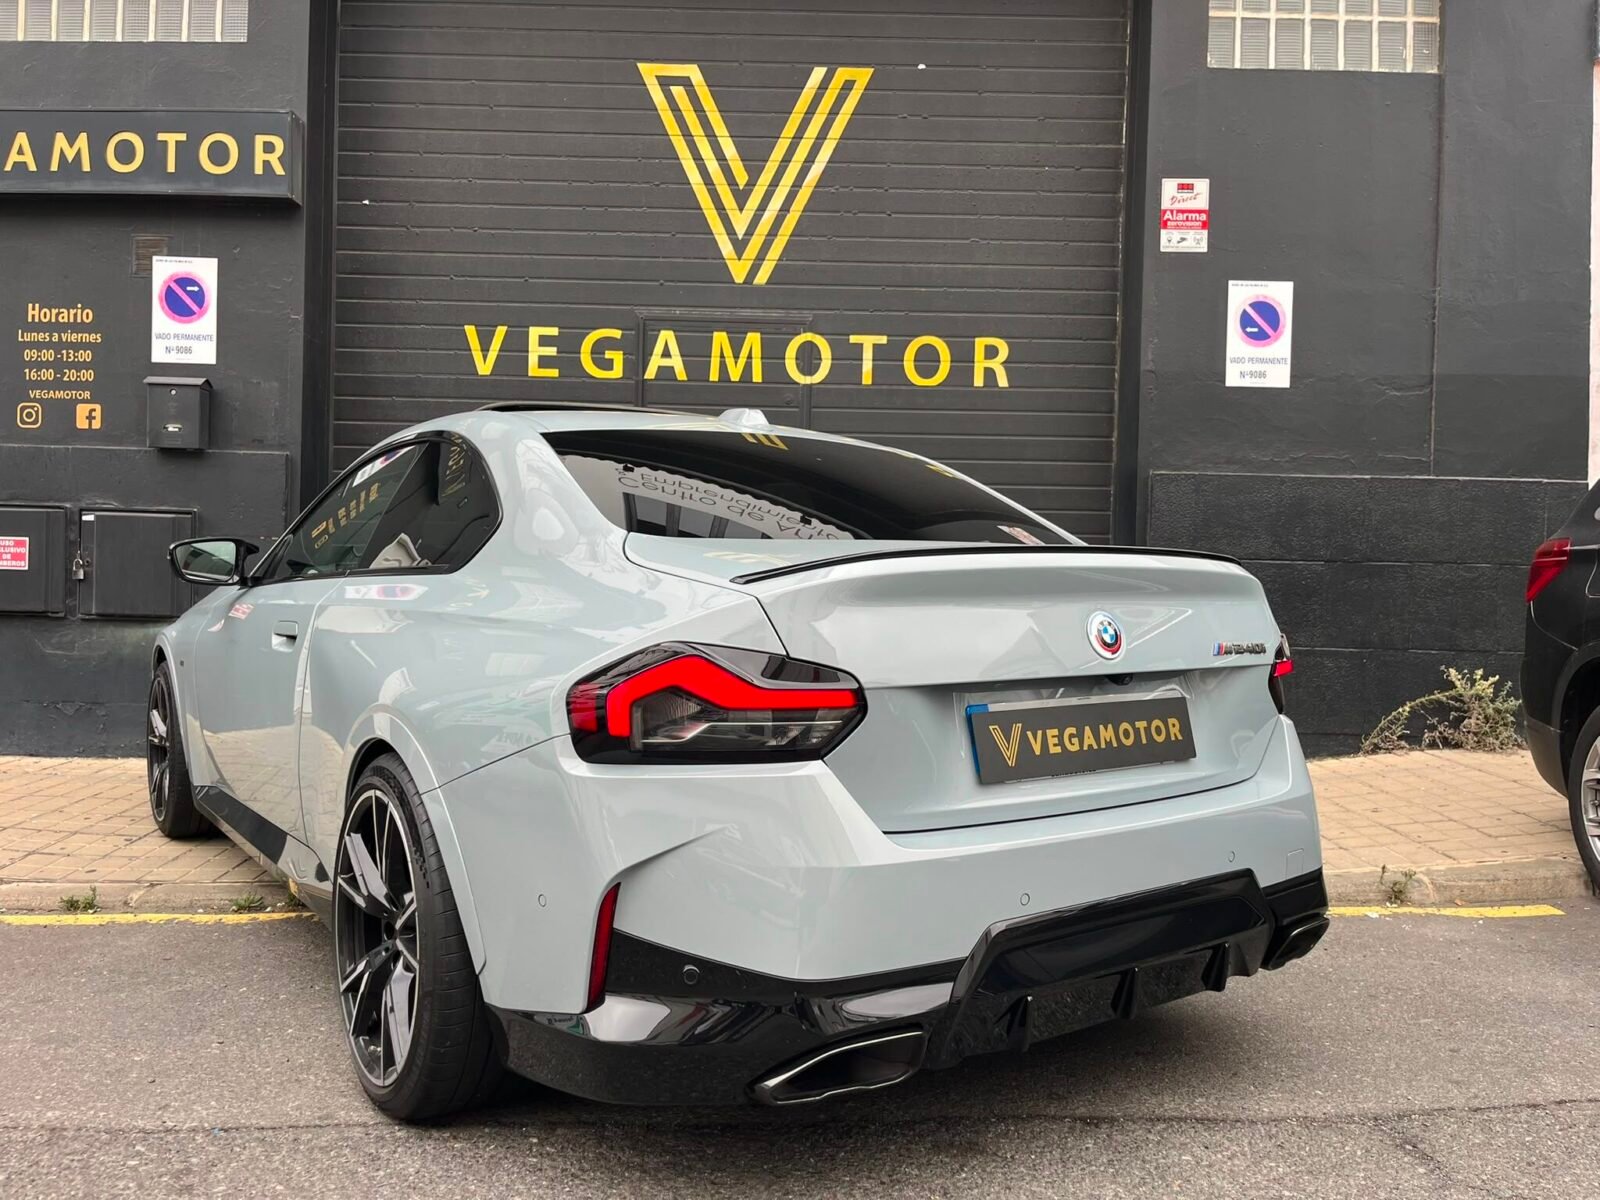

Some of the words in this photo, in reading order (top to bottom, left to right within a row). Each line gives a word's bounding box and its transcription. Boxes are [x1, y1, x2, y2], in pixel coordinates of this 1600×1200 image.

[3, 131, 286, 176] AMOTOR
[1163, 210, 1207, 221] Alarma
[27, 303, 94, 323] Horario
[18, 329, 50, 342] Lunes
[52, 333, 59, 342] a
[61, 330, 102, 343] viernes
[155, 332, 172, 341] VADO
[173, 333, 214, 342] PERMANENTE
[24, 349, 55, 361] 09:00
[463, 324, 1011, 389] VEGAMOTOR
[1229, 356, 1246, 365] VADO
[1247, 357, 1289, 366] PERMANENTE
[23, 368, 55, 381] 16:00
[63, 369, 94, 382] 20:00
[29, 390, 91, 400] VEGAMOTOR
[1026, 717, 1183, 756] VEGAMOTOR
